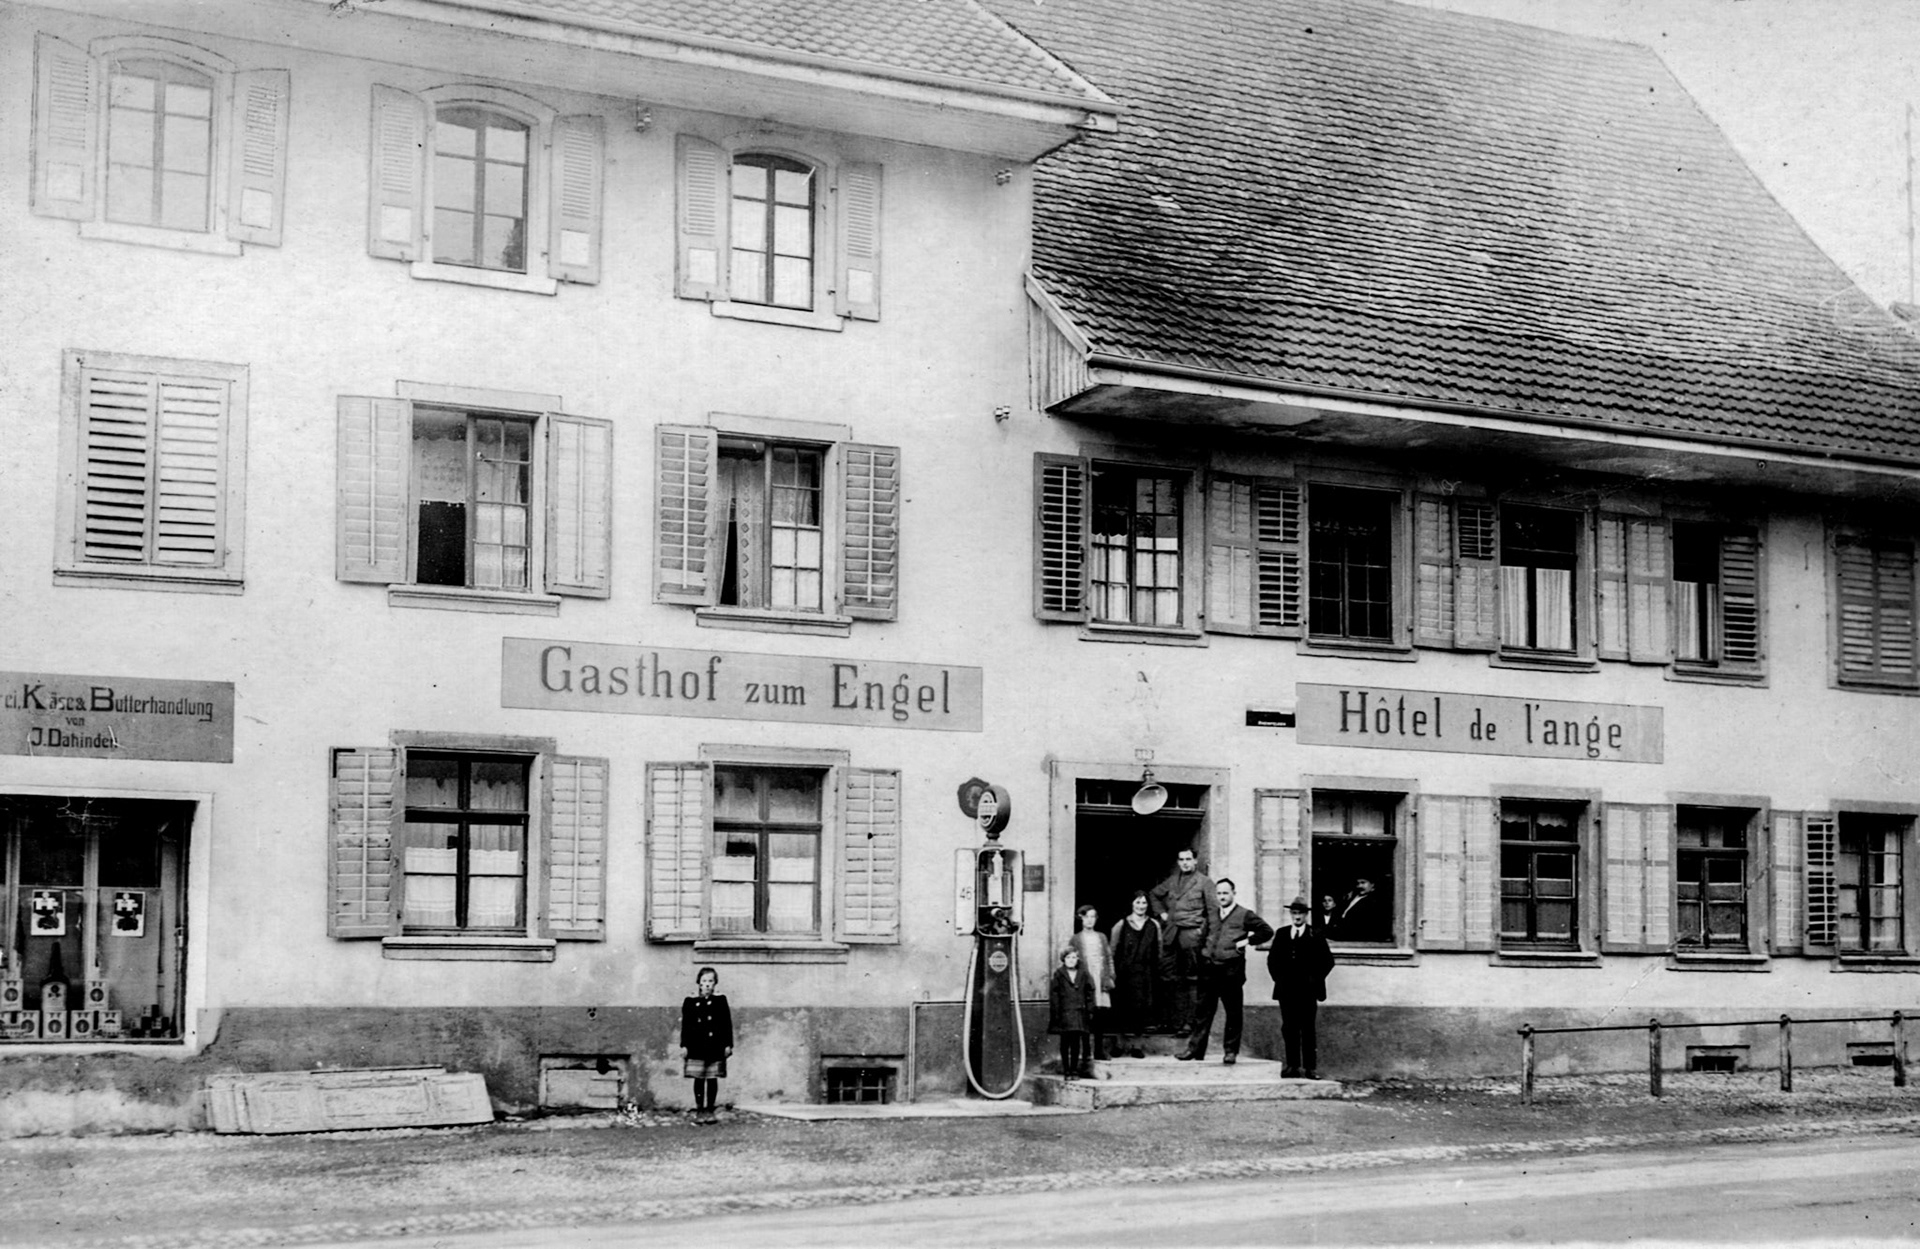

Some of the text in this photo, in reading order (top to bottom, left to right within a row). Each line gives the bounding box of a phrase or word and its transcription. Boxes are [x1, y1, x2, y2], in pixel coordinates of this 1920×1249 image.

[90, 686, 214, 722] Butterhandlung
[539, 644, 951, 721] Gasthof zum Engel
[1338, 690, 1623, 759] Hôtel de l'ange
